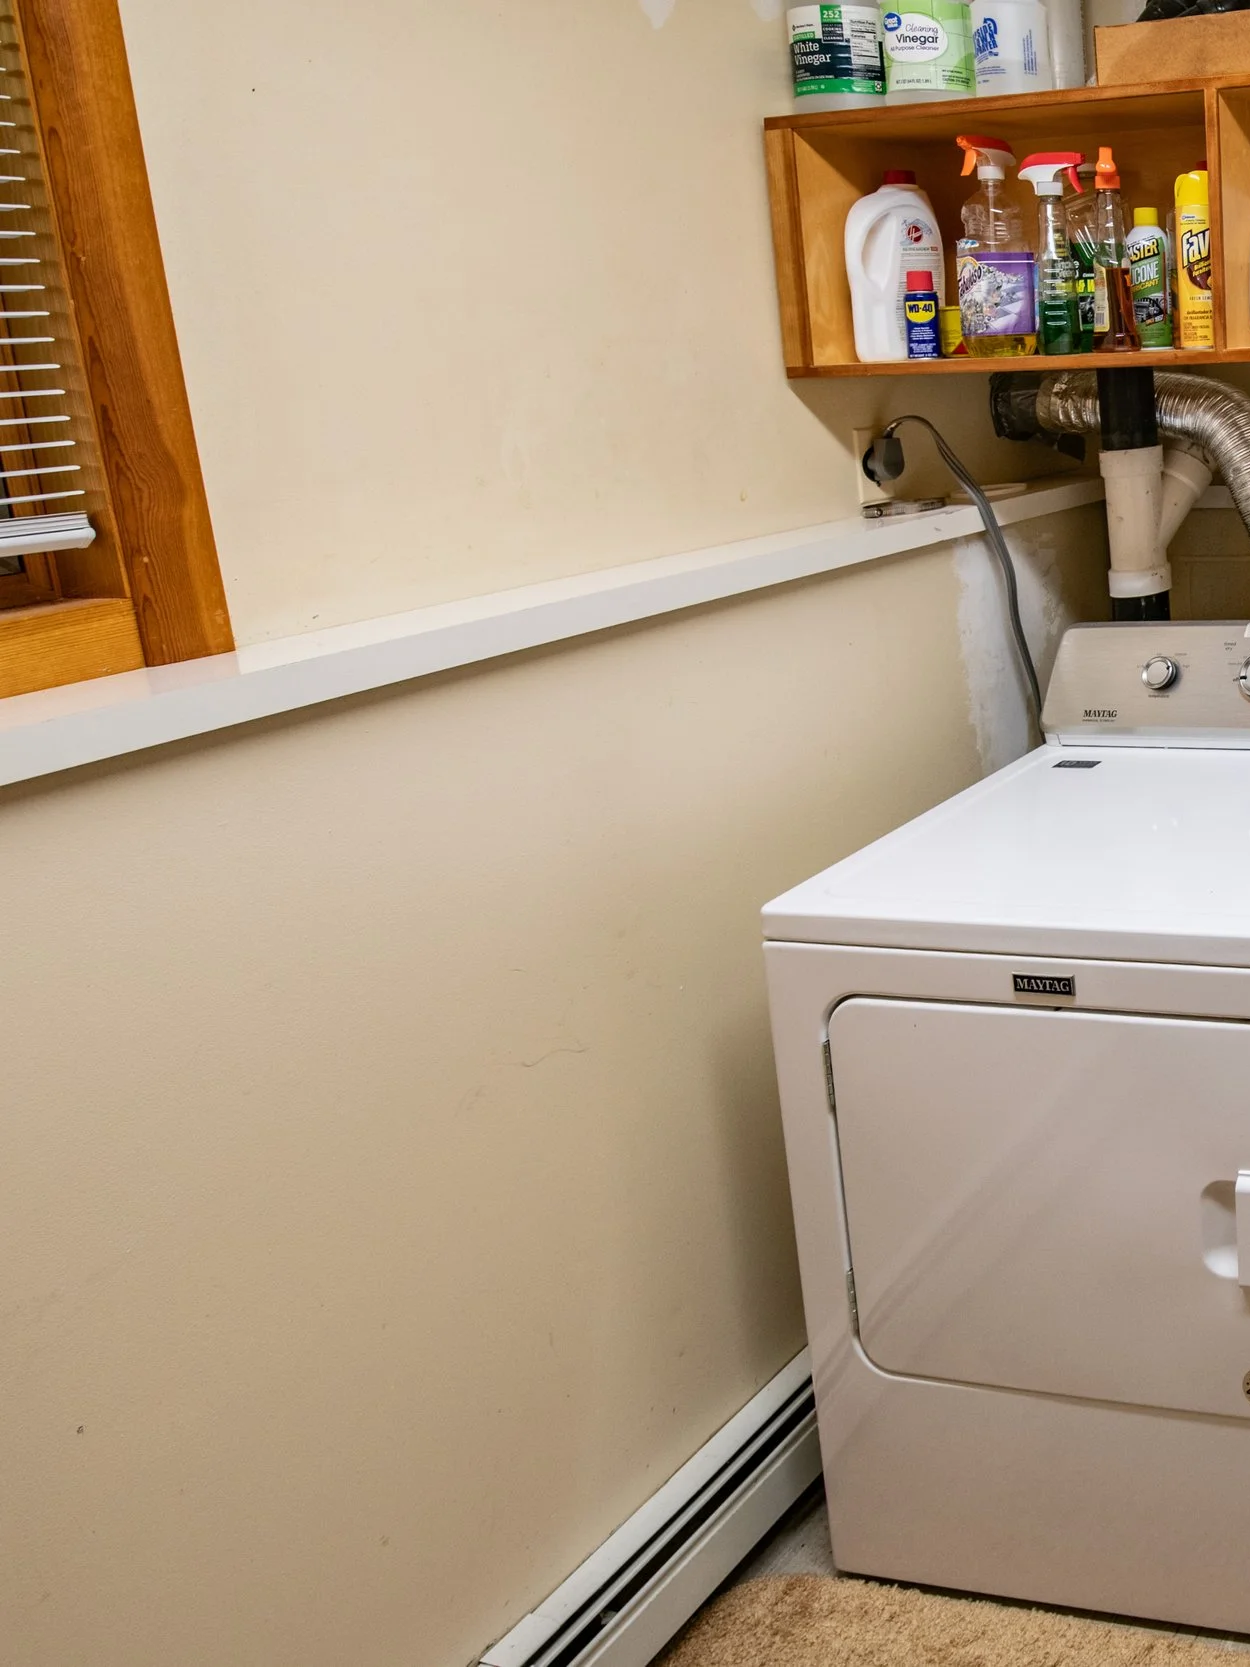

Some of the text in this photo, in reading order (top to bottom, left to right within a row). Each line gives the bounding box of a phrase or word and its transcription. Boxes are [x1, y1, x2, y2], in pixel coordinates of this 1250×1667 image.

[823, 10, 840, 19] 252
[905, 23, 939, 36] Cleaning
[896, 34, 939, 45] Vinegar
[794, 41, 820, 54] White
[795, 54, 832, 66] Vinegar
[1127, 238, 1160, 262] ASTER
[1182, 229, 1211, 269] Fav
[1131, 261, 1160, 285] ICONE
[907, 303, 933, 313] WD-40
[1082, 709, 1118, 718] MAYTAG
[1015, 978, 1070, 992] MAYTAG
